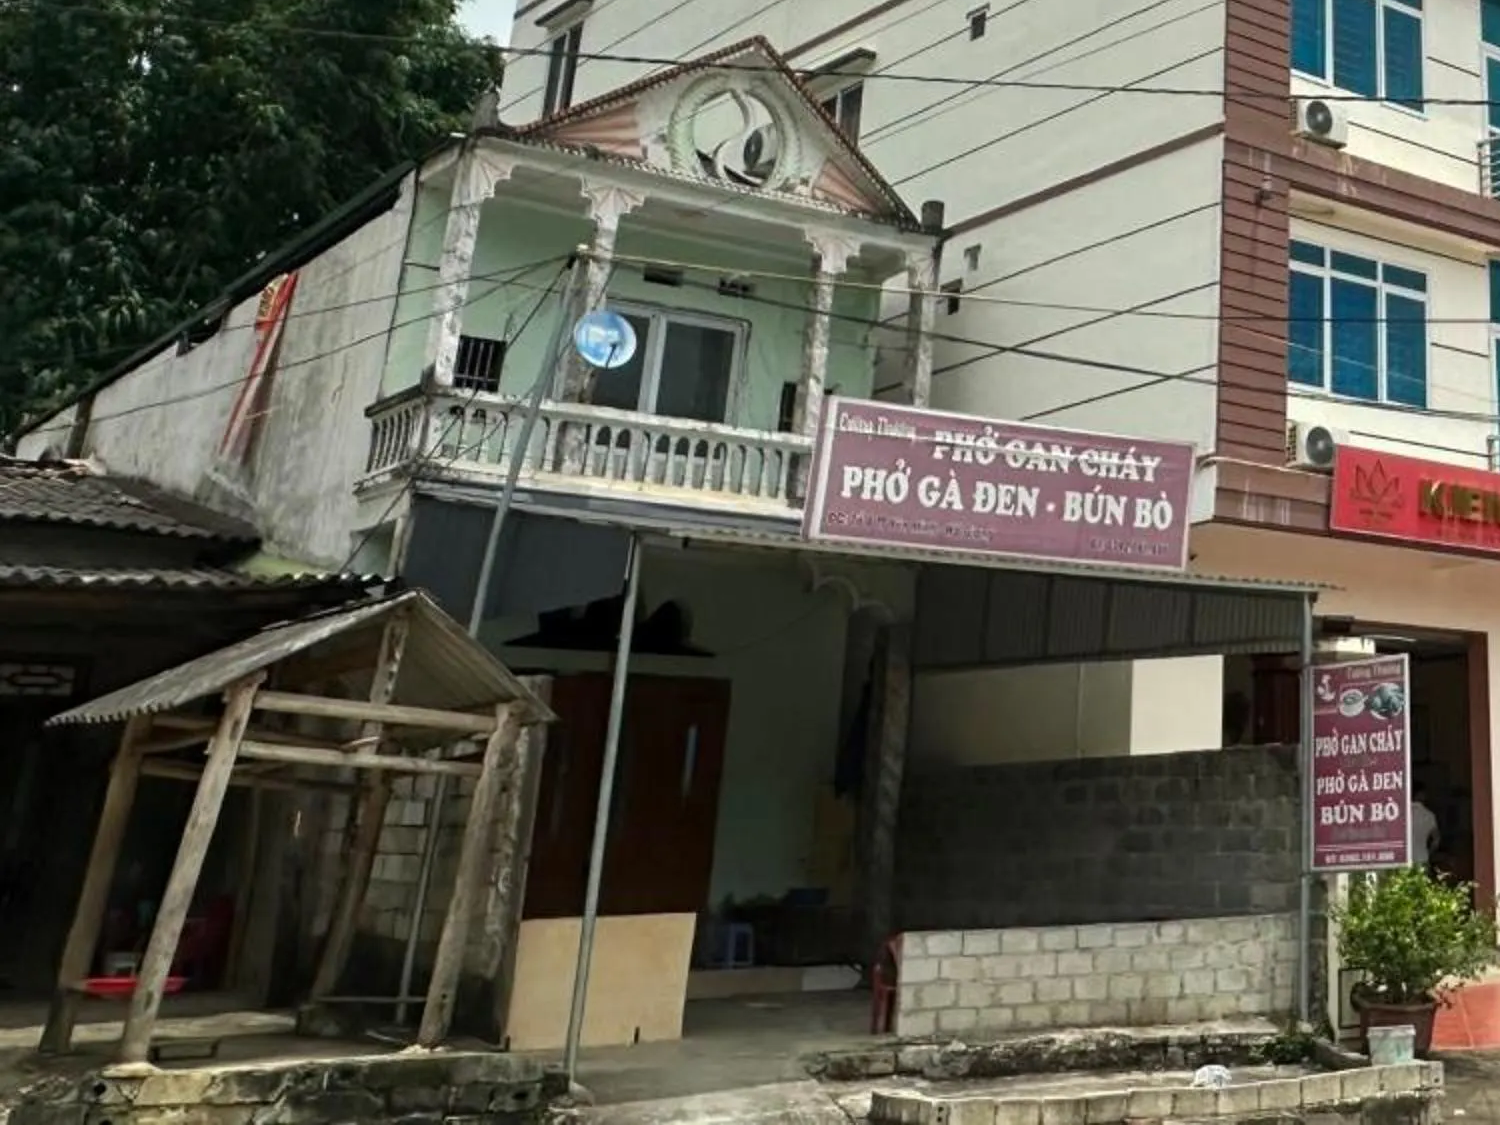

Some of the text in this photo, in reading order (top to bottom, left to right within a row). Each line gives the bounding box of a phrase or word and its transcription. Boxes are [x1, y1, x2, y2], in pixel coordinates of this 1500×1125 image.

[841, 458, 1173, 530] PHỞ GÀ ĐEN BÚN BÒ
[1341, 733, 1367, 755] GAN
[1348, 769, 1369, 792] GÀ
[1321, 796, 1399, 824] BÚN BÒ
